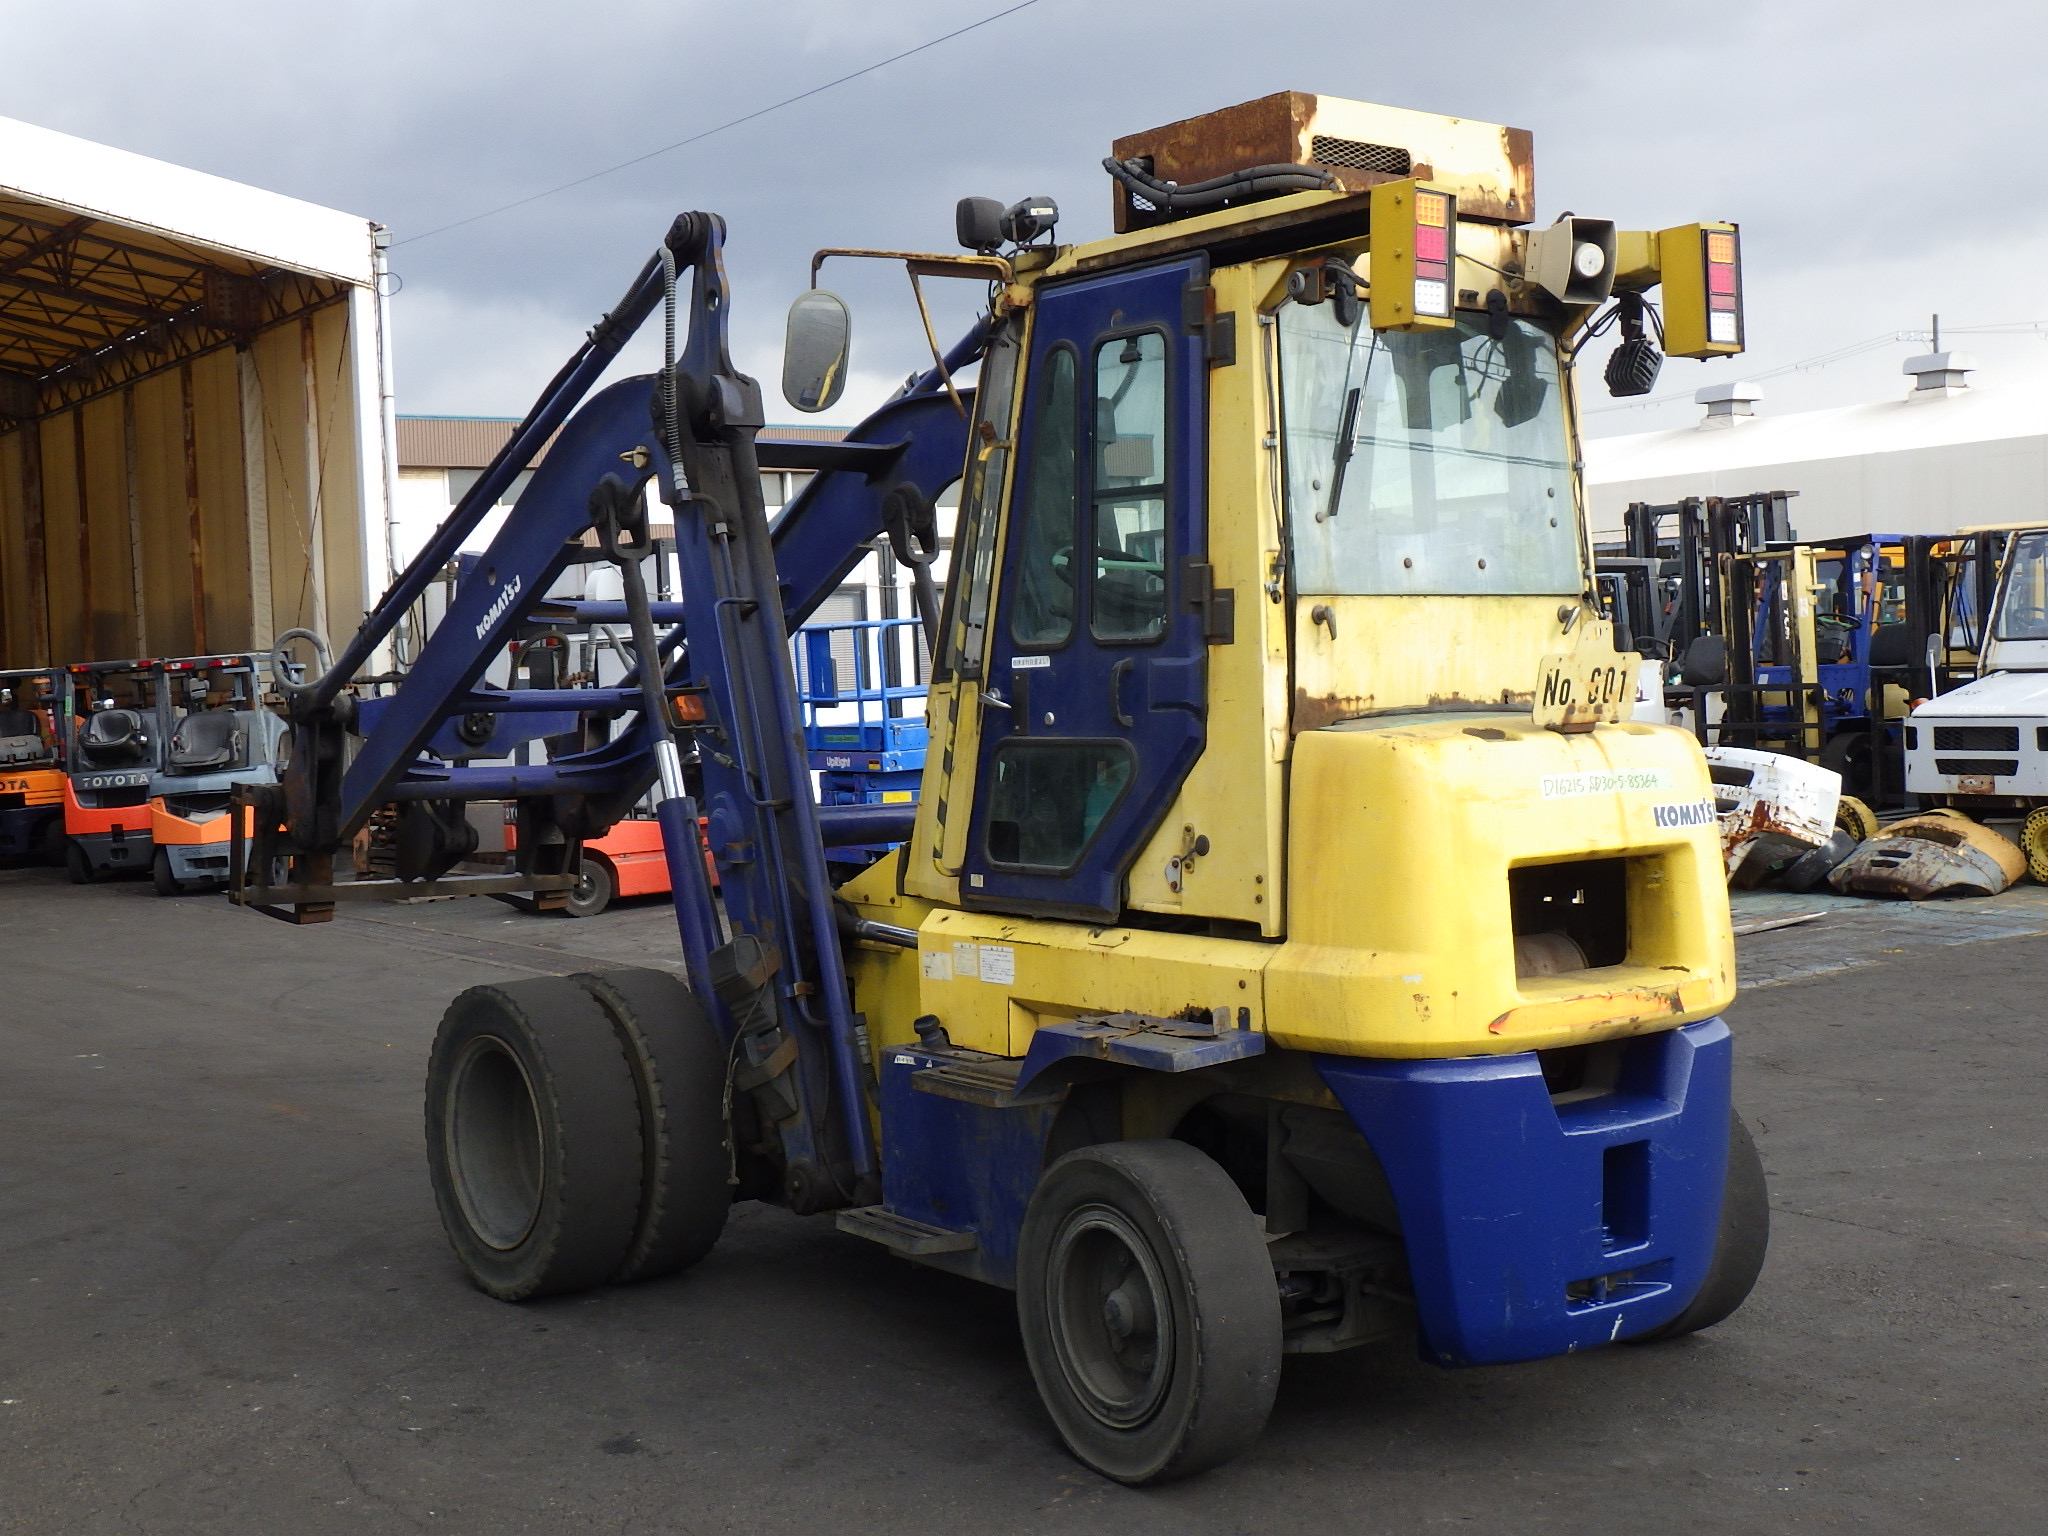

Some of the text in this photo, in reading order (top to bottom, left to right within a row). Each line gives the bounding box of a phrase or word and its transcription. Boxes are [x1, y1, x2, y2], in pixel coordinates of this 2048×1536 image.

[1542, 668, 1576, 706] No.
[82, 773, 150, 788] TOYOTA
[1543, 778, 1585, 797] D16215
[1653, 797, 1717, 828] KOMATS
